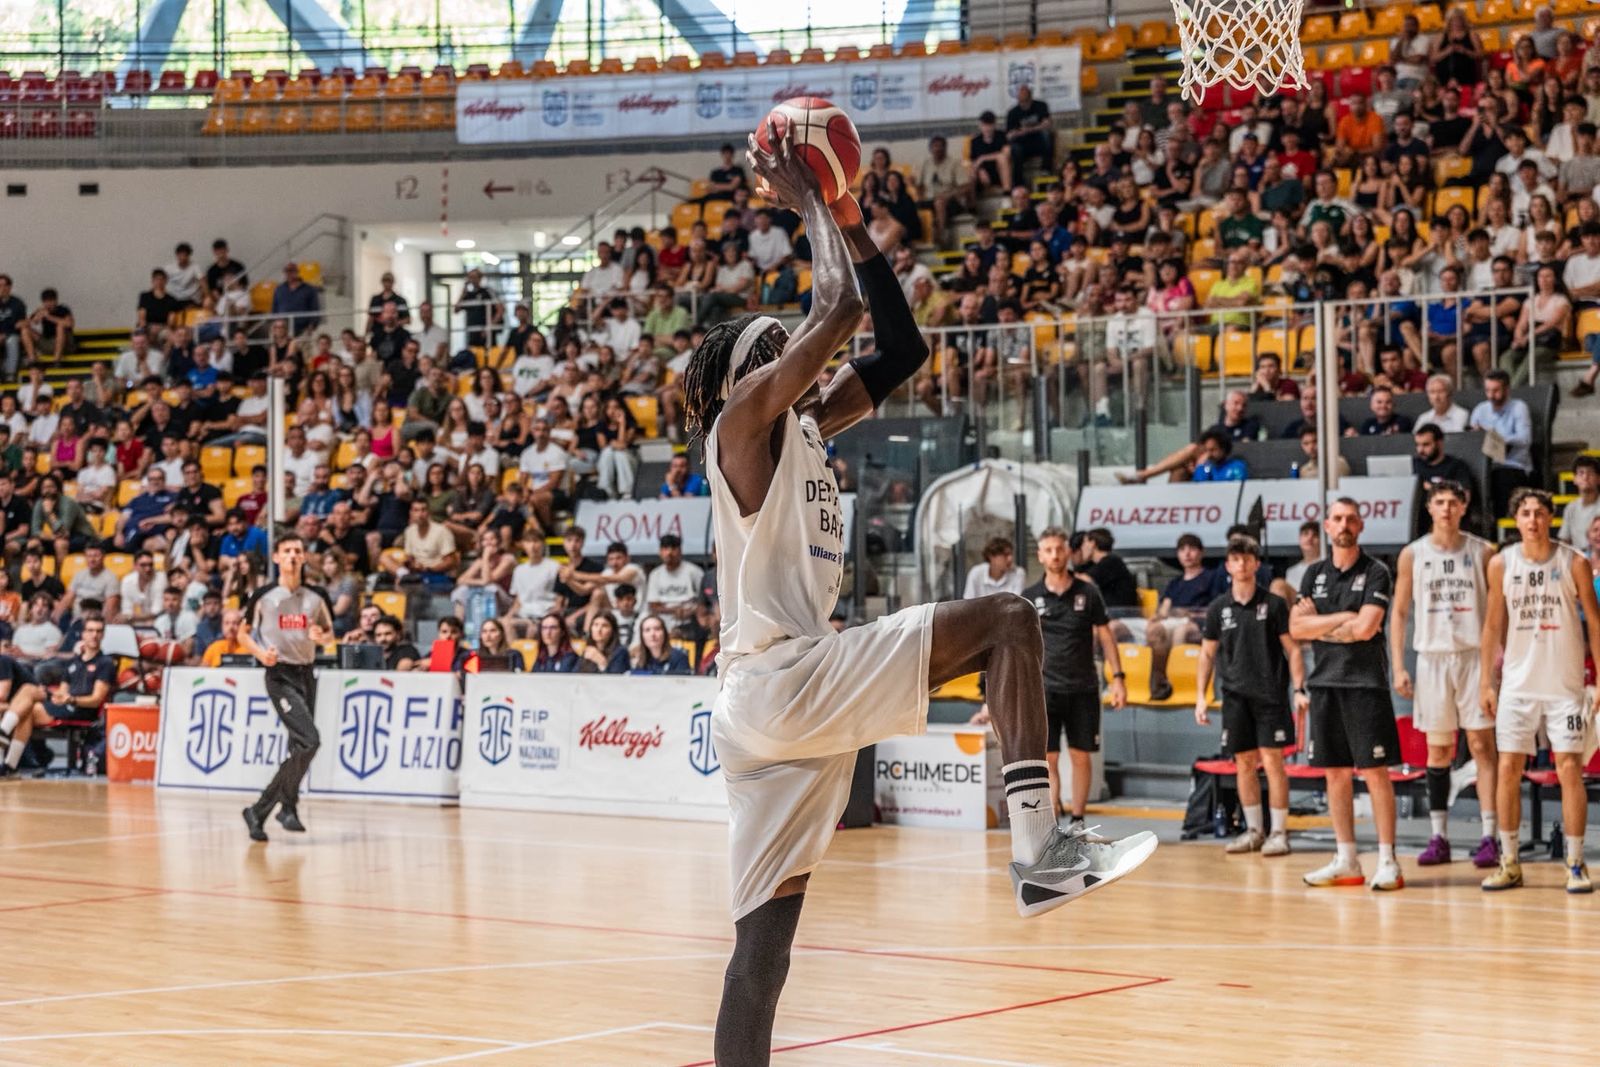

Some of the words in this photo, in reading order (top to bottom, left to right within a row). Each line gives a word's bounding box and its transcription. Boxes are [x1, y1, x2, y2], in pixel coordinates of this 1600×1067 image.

[1090, 505, 1222, 526] PALAZZETTO
[1265, 502, 1320, 521] ELLO
[1358, 500, 1402, 518] ORT
[595, 513, 682, 543] ROMA
[1443, 559, 1455, 574] 10
[1529, 570, 1544, 588] 88
[521, 709, 549, 723] FIP
[1567, 715, 1582, 731] 88
[243, 734, 289, 765] LAZI
[579, 716, 664, 758] Kellogg's
[400, 736, 462, 771] LAZIO
[876, 760, 982, 784] RCHIMEDE
